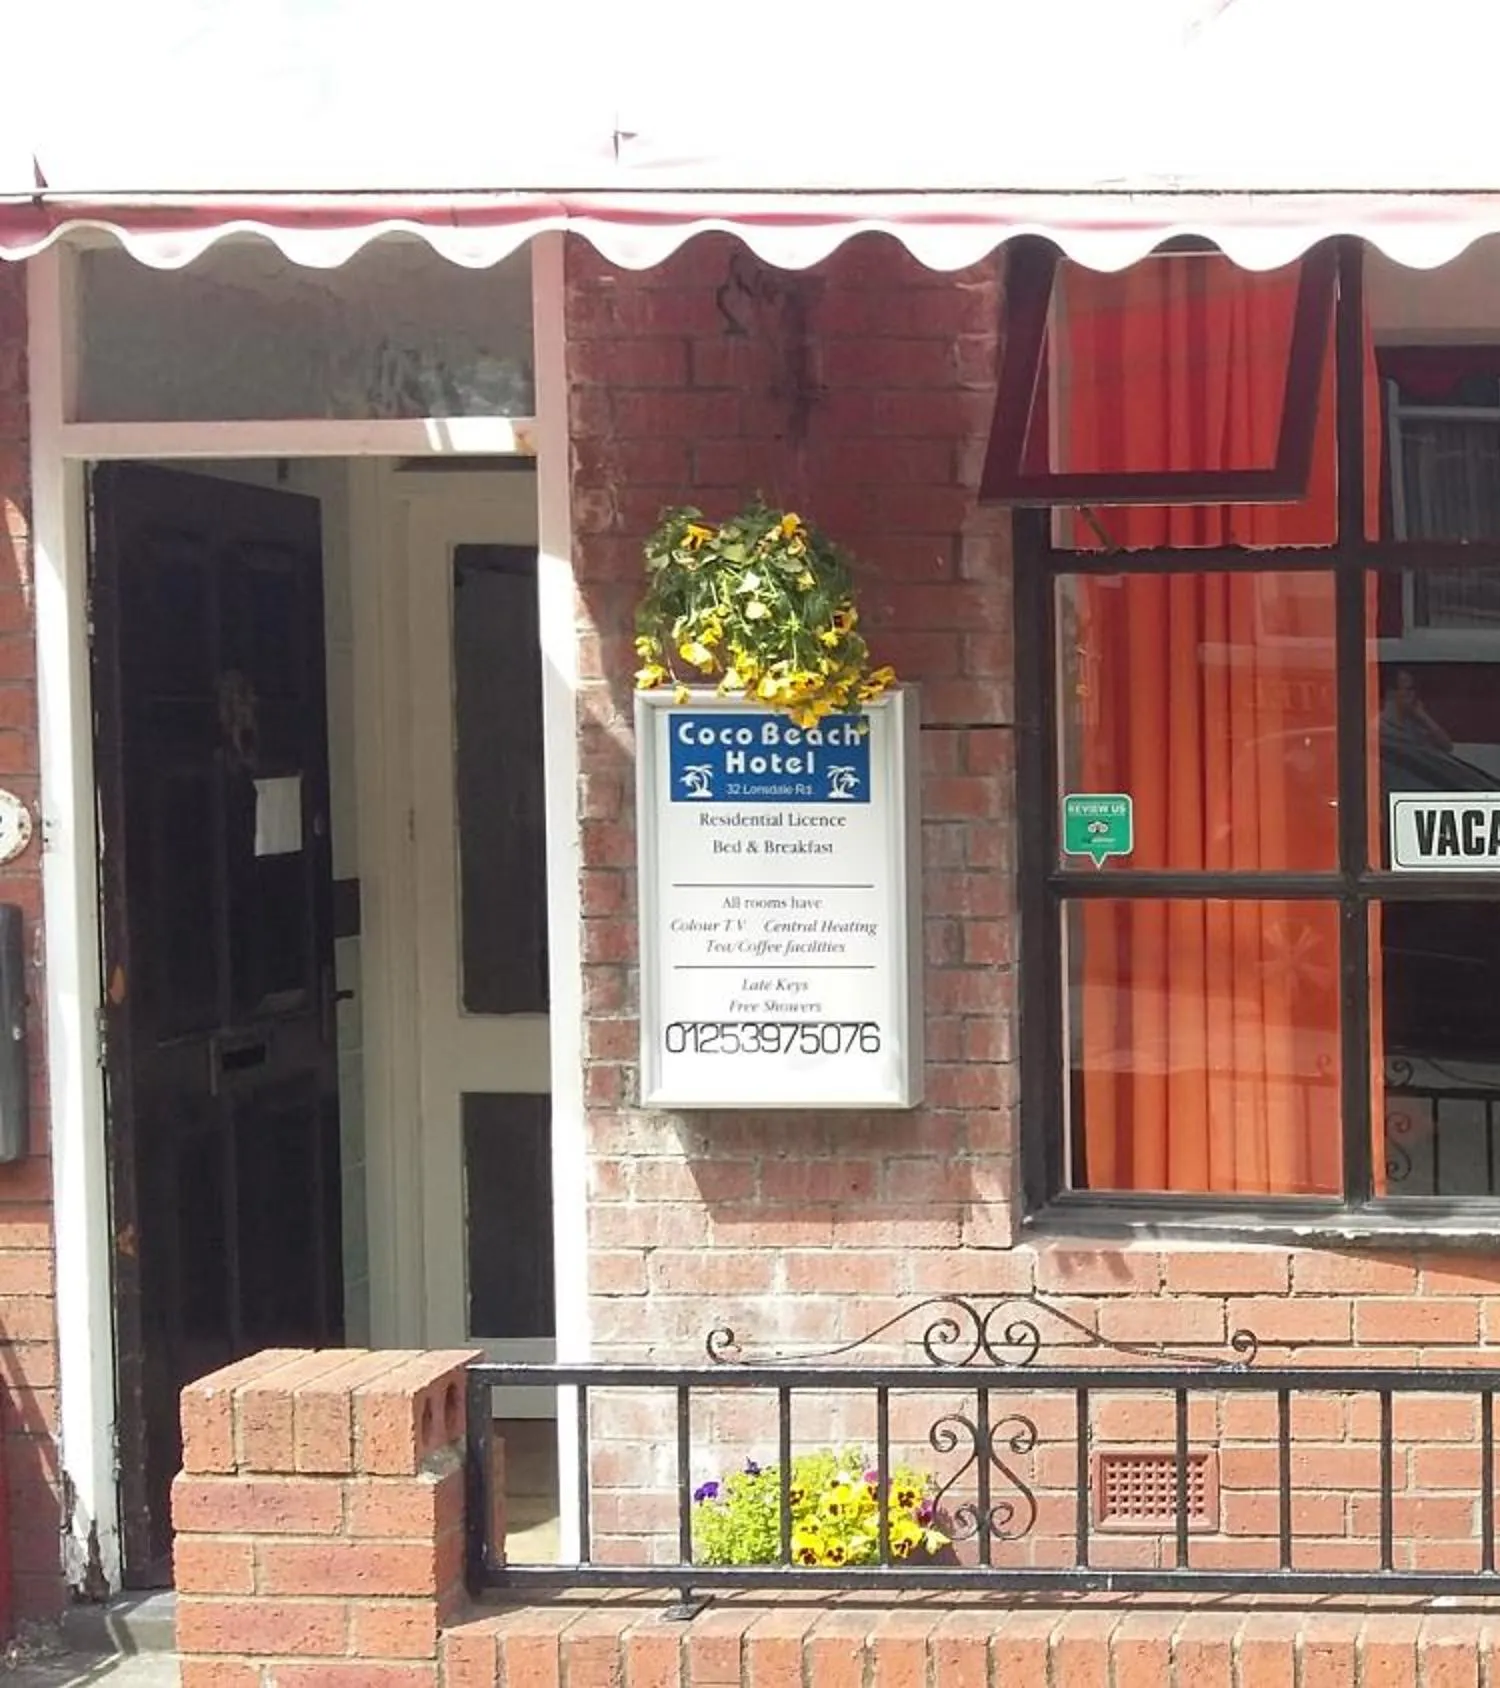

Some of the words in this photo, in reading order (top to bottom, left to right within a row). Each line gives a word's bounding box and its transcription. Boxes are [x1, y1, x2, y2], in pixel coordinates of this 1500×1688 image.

[678, 721, 753, 745] Coco
[761, 721, 861, 746] Beach
[725, 750, 816, 774] Hotel
[727, 783, 741, 795] 32
[743, 783, 793, 796] Lonsdale
[1111, 803, 1126, 813] US
[699, 812, 784, 827] Residential
[787, 812, 847, 828] Licence
[713, 839, 742, 855] Bed
[746, 840, 758, 854] &
[764, 839, 834, 855] Breakfast
[721, 896, 741, 909] All
[744, 898, 787, 909] rooms
[791, 896, 823, 909] have
[671, 918, 720, 932] Colour
[763, 919, 818, 933] Central
[821, 919, 879, 936] Heating
[706, 939, 783, 957] Tea/Coffee
[783, 939, 846, 957] facilities
[742, 978, 773, 991] Late
[775, 978, 809, 993] Keys
[729, 1000, 760, 1013] Free
[763, 1000, 822, 1014] Showers
[665, 1021, 881, 1054] 01253975076
